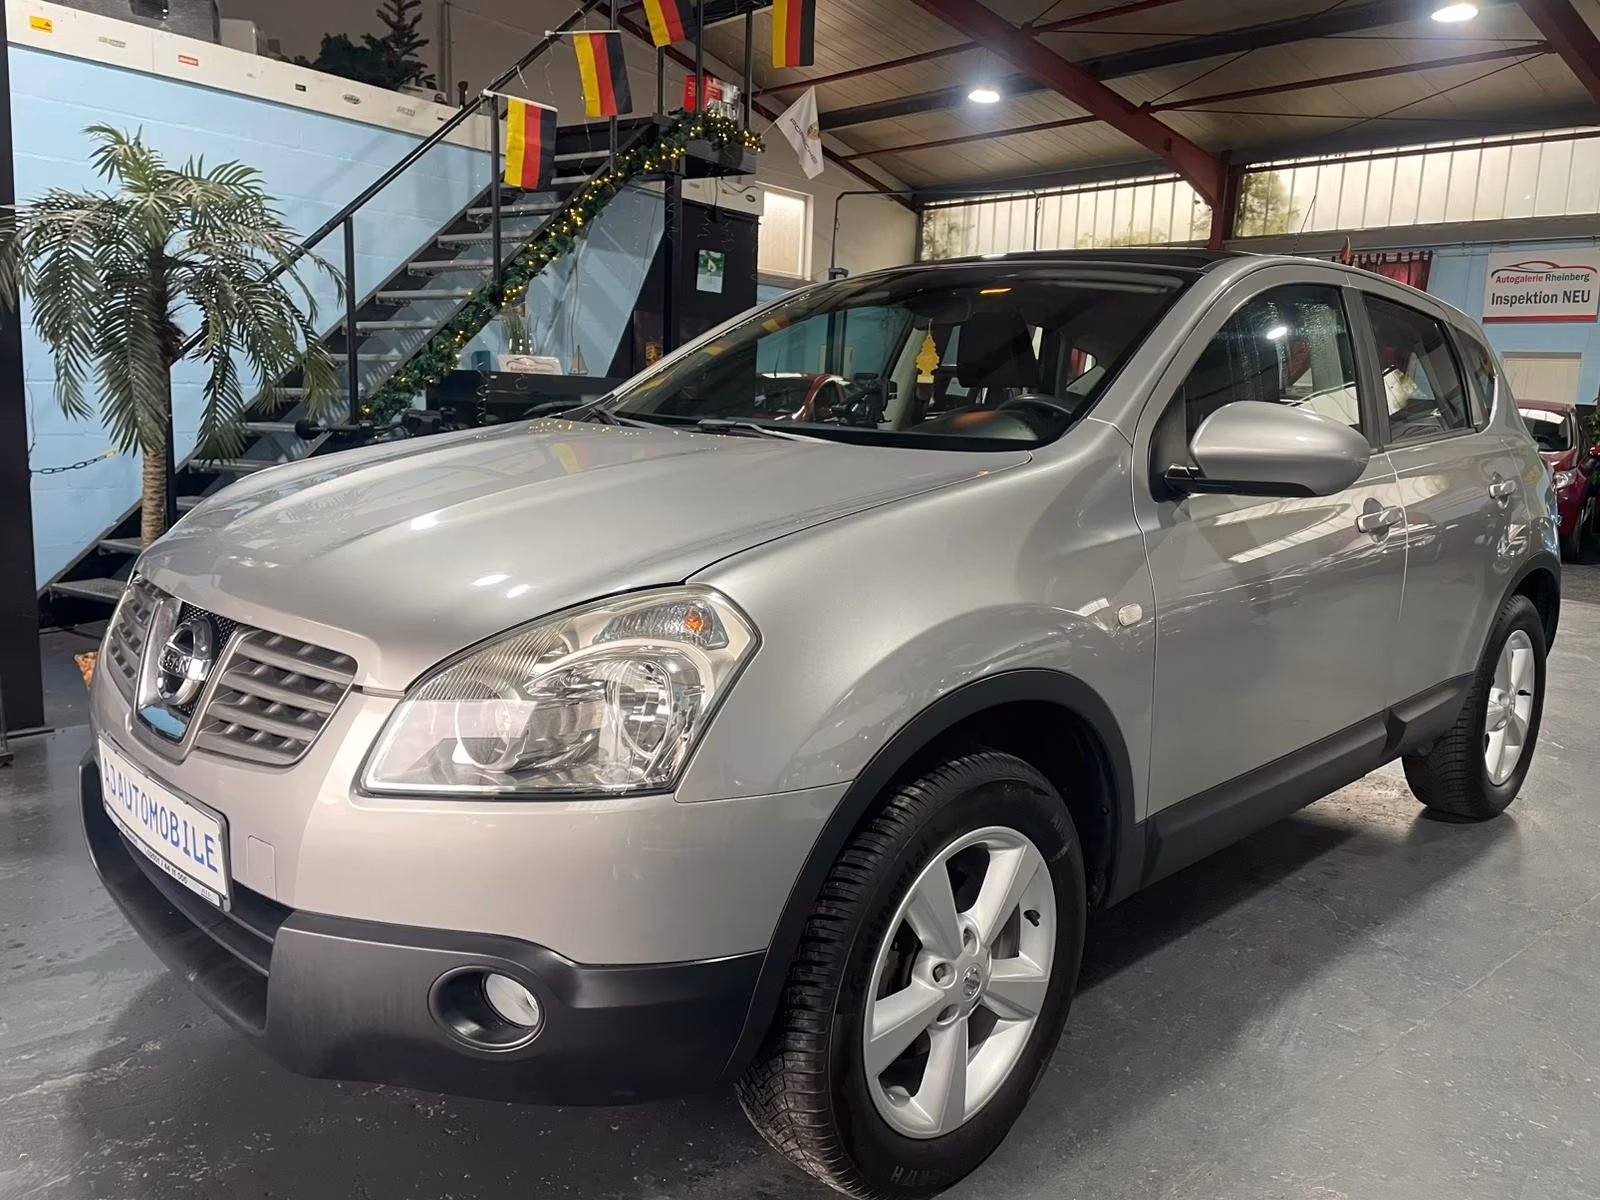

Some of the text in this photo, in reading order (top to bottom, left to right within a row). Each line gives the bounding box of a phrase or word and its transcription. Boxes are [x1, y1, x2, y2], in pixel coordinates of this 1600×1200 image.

[1495, 272, 1590, 285] Autogalerie Rheinberg
[1491, 289, 1591, 308] Inspektion NEU
